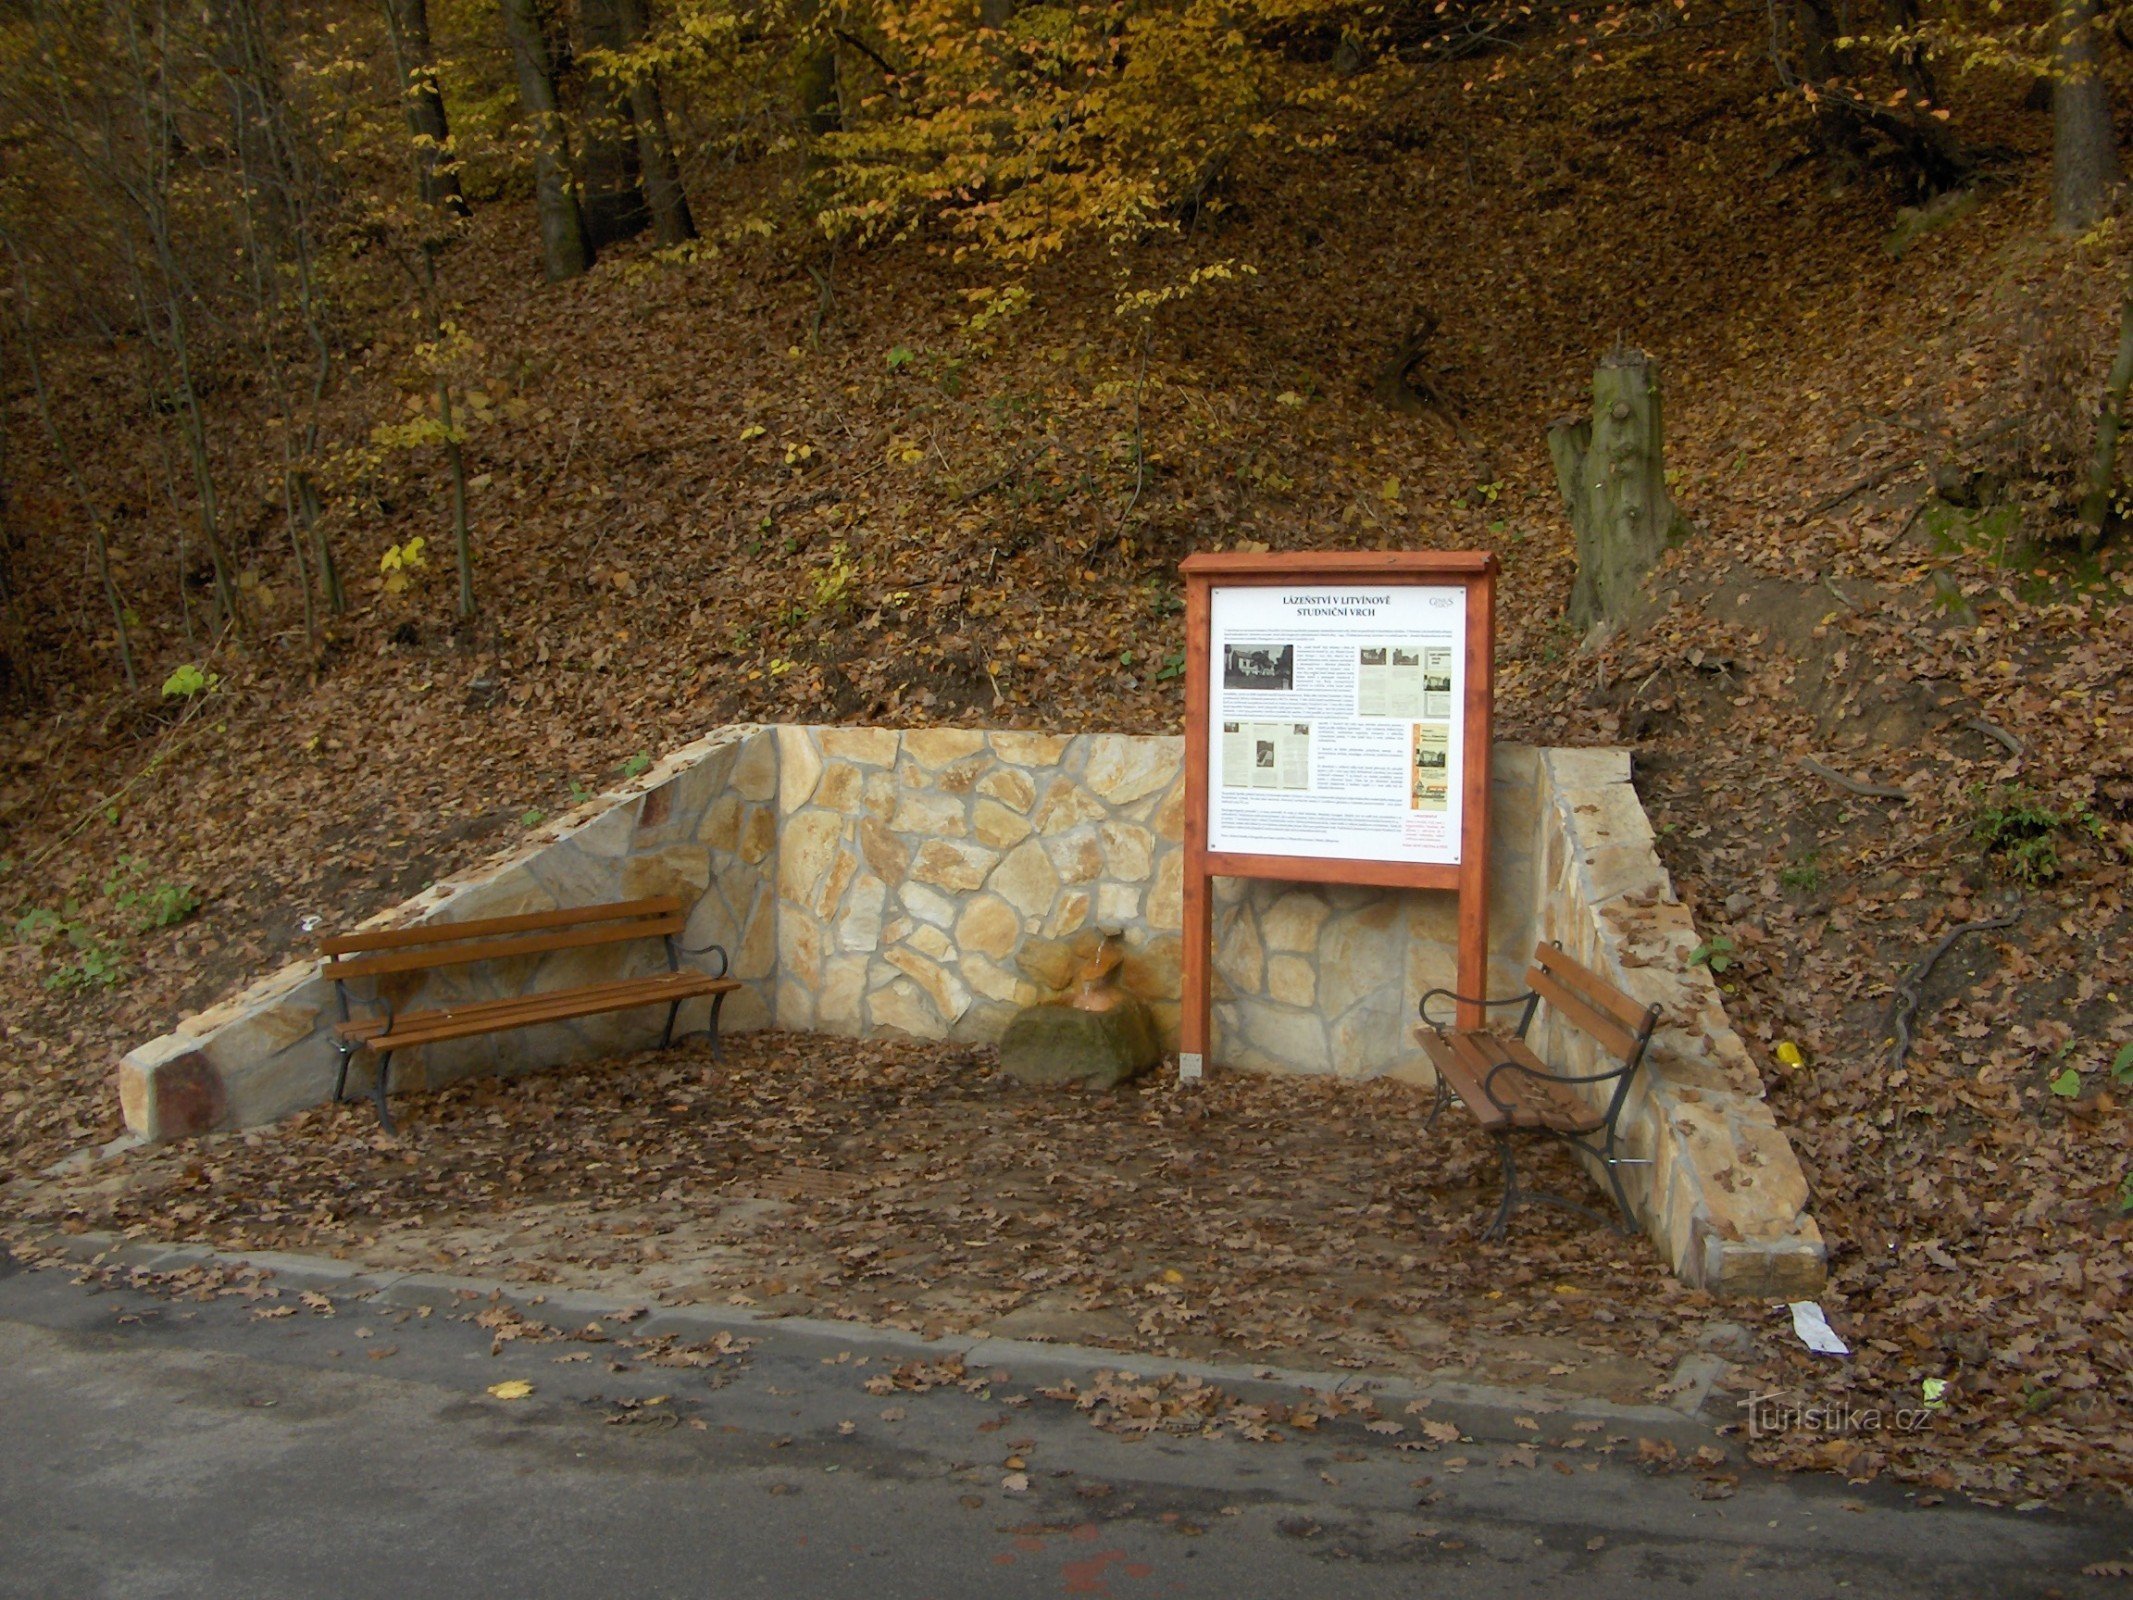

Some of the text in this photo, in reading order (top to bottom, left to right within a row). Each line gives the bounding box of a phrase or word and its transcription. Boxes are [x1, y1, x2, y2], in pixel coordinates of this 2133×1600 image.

[1333, 596, 1340, 604] V
[1297, 607, 1375, 616] STUDNIČNÍ VRCH
